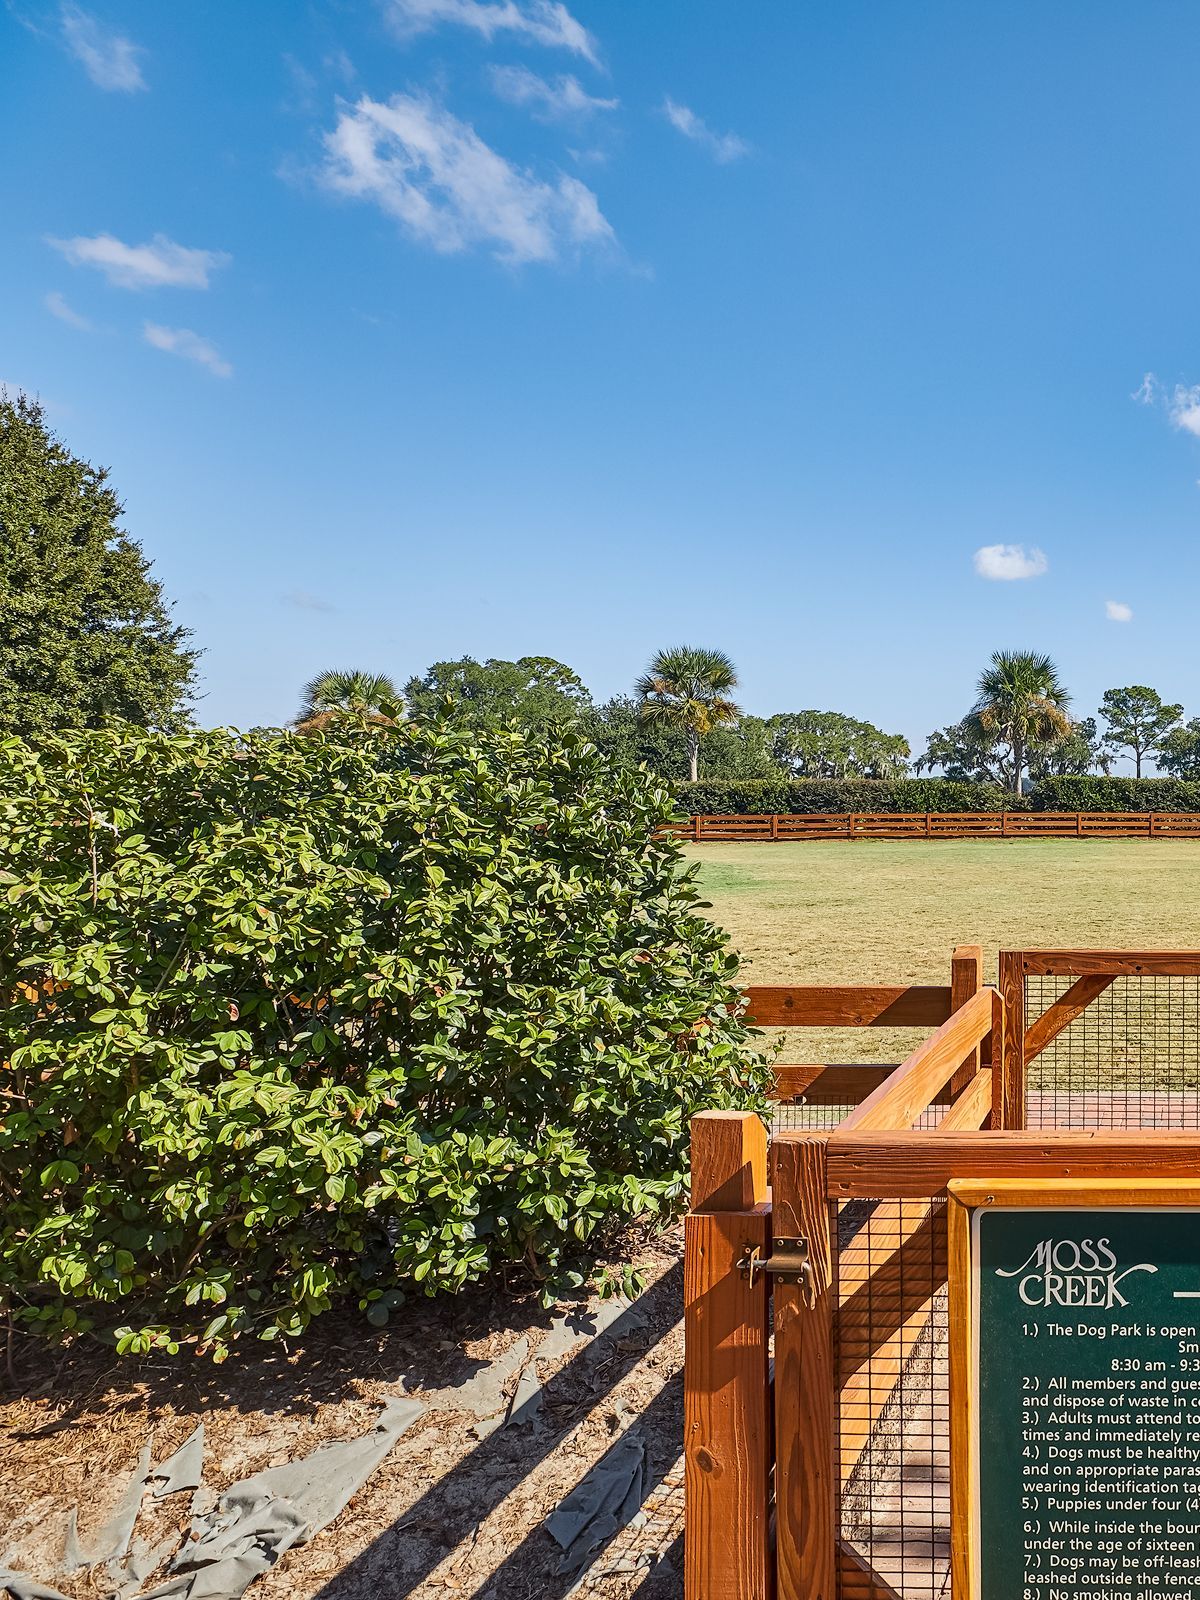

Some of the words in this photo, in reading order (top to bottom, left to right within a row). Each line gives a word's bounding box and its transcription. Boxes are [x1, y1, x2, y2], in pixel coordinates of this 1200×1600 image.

[995, 1237, 1117, 1277] MOSS
[1018, 1263, 1159, 1310] CREEK
[1022, 1322, 1039, 1338] 1.)
[1046, 1323, 1073, 1337] The
[1077, 1323, 1107, 1340] Dog
[1111, 1323, 1142, 1337] Park
[1146, 1323, 1156, 1337] is
[1160, 1326, 1196, 1340] open
[1110, 1358, 1141, 1371] 8:30
[1144, 1361, 1166, 1372] am
[1022, 1376, 1040, 1392] 2.)
[1047, 1376, 1067, 1390] All
[1071, 1376, 1136, 1390] members
[1140, 1376, 1167, 1390] and
[1022, 1393, 1049, 1407] and
[1052, 1393, 1105, 1410] dispose
[1109, 1393, 1125, 1407] of
[1127, 1395, 1170, 1408] waste
[1173, 1394, 1187, 1408] in
[1021, 1410, 1039, 1426] 3.)
[1047, 1410, 1093, 1425] Adults
[1097, 1412, 1132, 1425] must
[1135, 1411, 1182, 1425] attend
[1021, 1427, 1061, 1441] times
[1064, 1428, 1091, 1442] and
[1095, 1428, 1183, 1445] immediately
[1021, 1445, 1040, 1460] 4.)
[1048, 1446, 1084, 1462] Dogs
[1087, 1447, 1122, 1459] must
[1125, 1445, 1144, 1459] be
[1022, 1462, 1049, 1476] and
[1053, 1465, 1072, 1476] on
[1075, 1463, 1159, 1479] appropriate
[1022, 1479, 1080, 1496] wearing
[1085, 1479, 1179, 1494] identification
[1021, 1496, 1039, 1512] 5.)
[1047, 1497, 1102, 1513] Puppies
[1105, 1497, 1148, 1511] under
[1150, 1497, 1182, 1511] four
[1023, 1519, 1041, 1535] 6.)
[1048, 1520, 1090, 1534] While
[1094, 1520, 1136, 1534] inside
[1138, 1520, 1163, 1534] the
[1024, 1536, 1066, 1550] under
[1069, 1537, 1093, 1551] the
[1097, 1540, 1123, 1554] age
[1127, 1537, 1143, 1551] of
[1145, 1538, 1195, 1551] sixteen
[1023, 1553, 1041, 1569] 7.)
[1050, 1554, 1085, 1571] Dogs
[1088, 1557, 1119, 1571] may
[1122, 1554, 1140, 1568] be
[1024, 1570, 1077, 1584] leashed
[1080, 1571, 1133, 1585] outside
[1135, 1571, 1160, 1585] the
[1049, 1588, 1069, 1600] No
[1072, 1588, 1132, 1600] smoking
